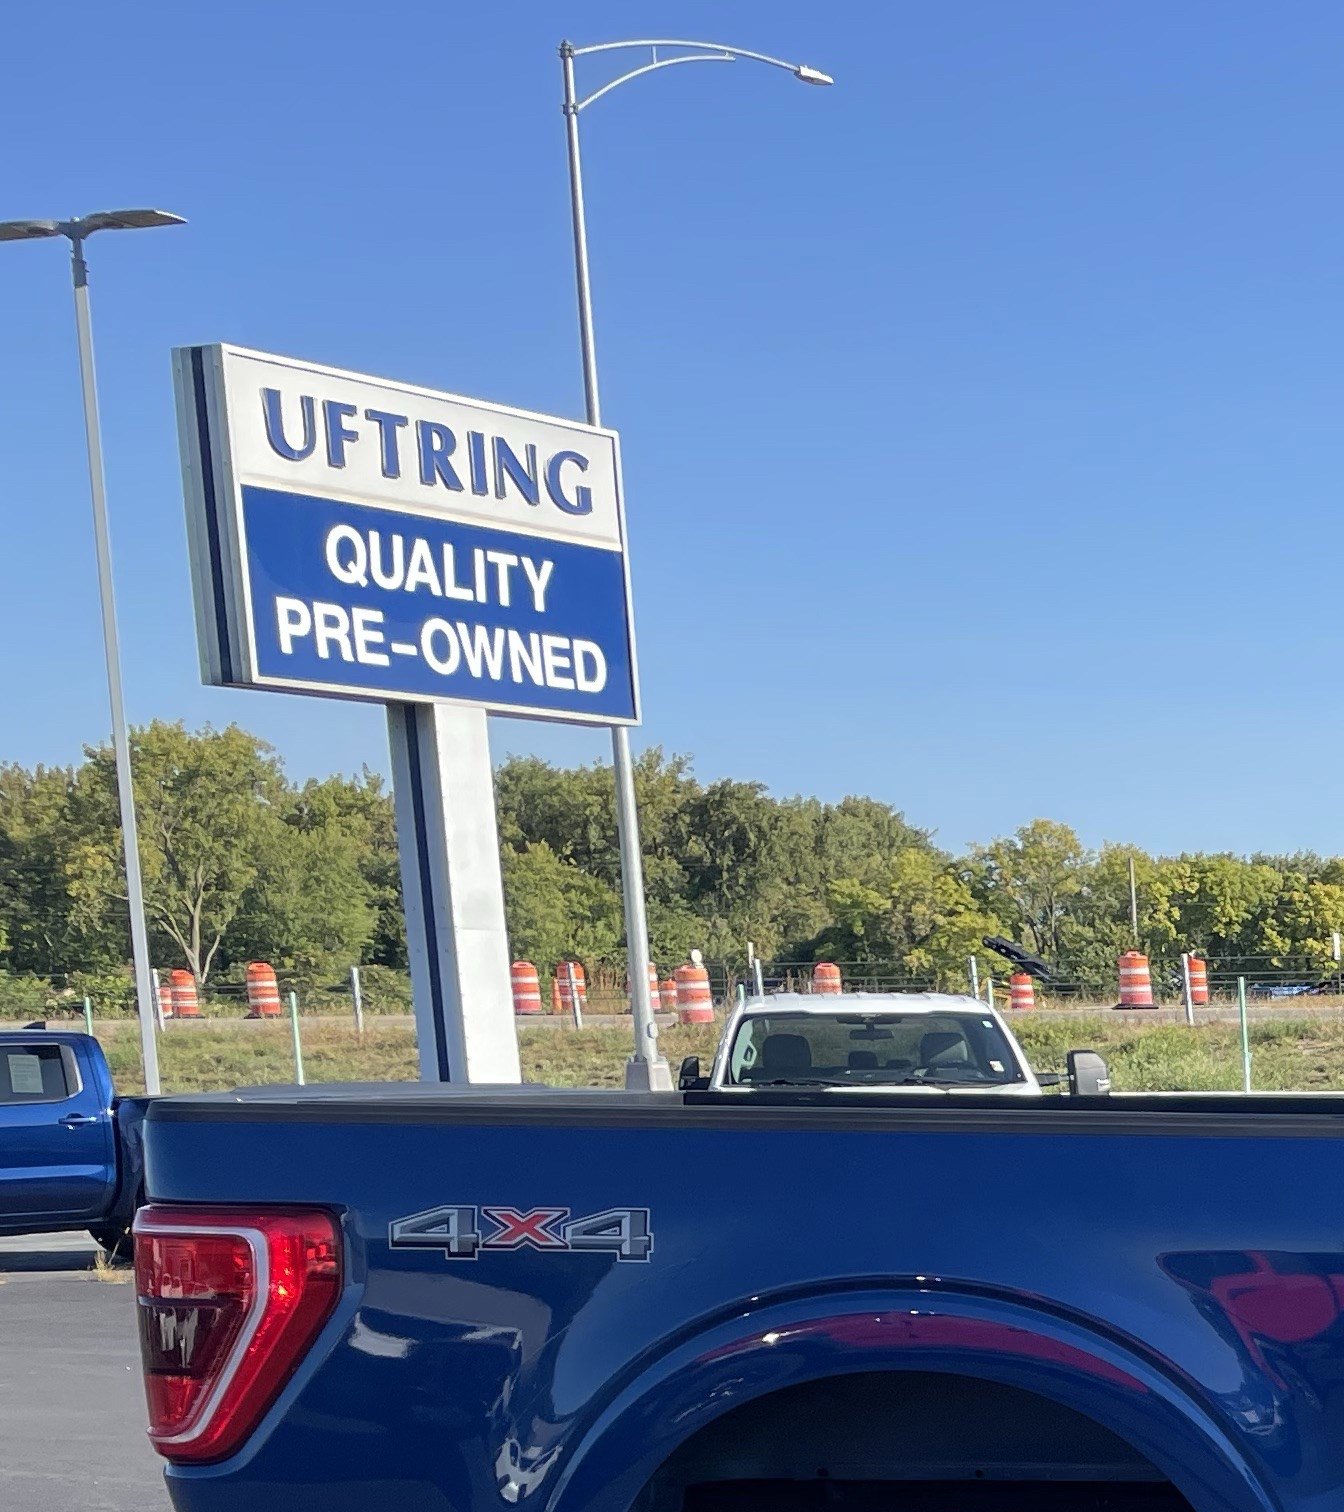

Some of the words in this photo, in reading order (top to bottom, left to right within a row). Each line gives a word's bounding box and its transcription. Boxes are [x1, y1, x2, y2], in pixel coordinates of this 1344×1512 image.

[260, 386, 593, 516] UFTRING
[325, 523, 554, 613] QUALITY
[274, 596, 608, 694] PRE-OWNED
